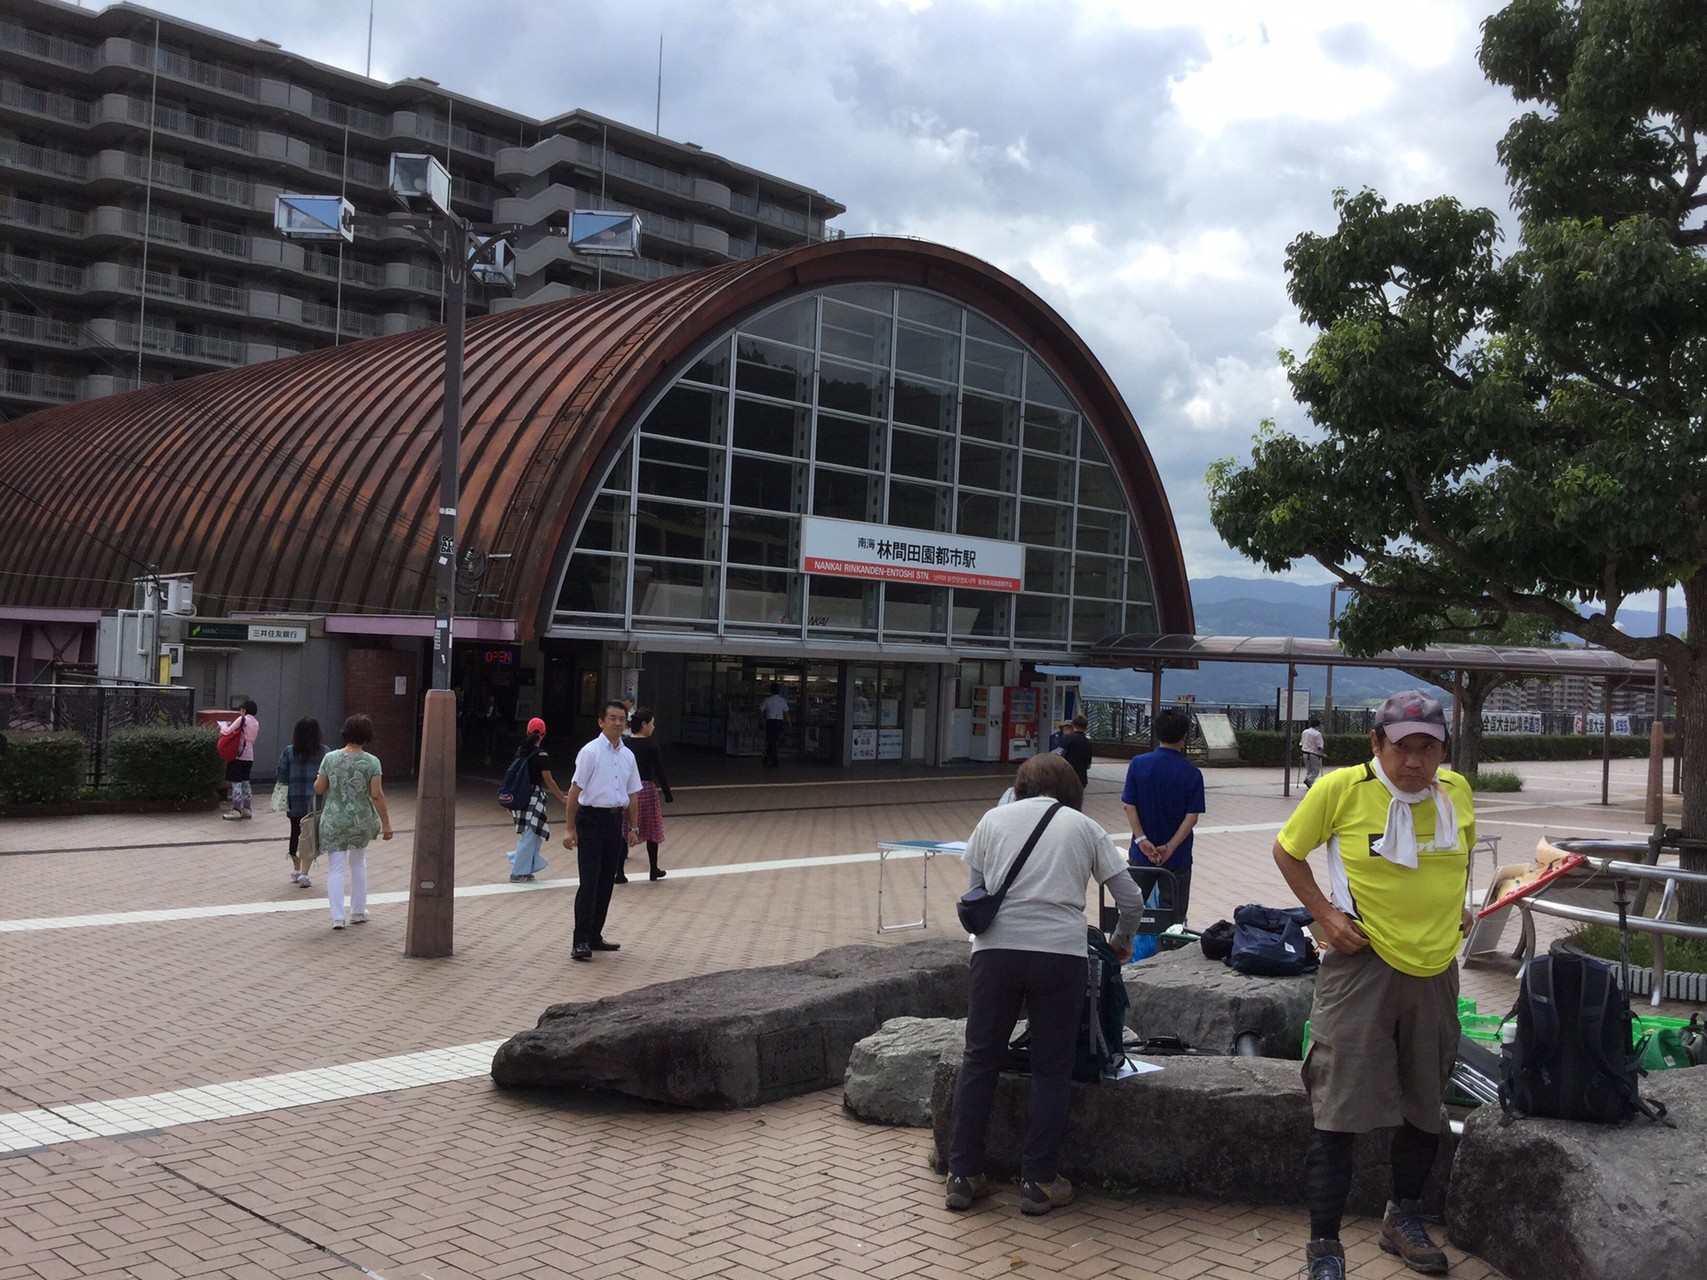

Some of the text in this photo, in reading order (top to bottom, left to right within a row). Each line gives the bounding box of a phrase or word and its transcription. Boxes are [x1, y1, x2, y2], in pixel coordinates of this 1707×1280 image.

[857, 537, 976, 568] 南海 林間田園都市駅
[814, 560, 930, 580] NANKAI RINKANDEN-ENTOSHI STN.
[252, 629, 298, 639] 三井住友銀行
[486, 650, 512, 663] OPEN
